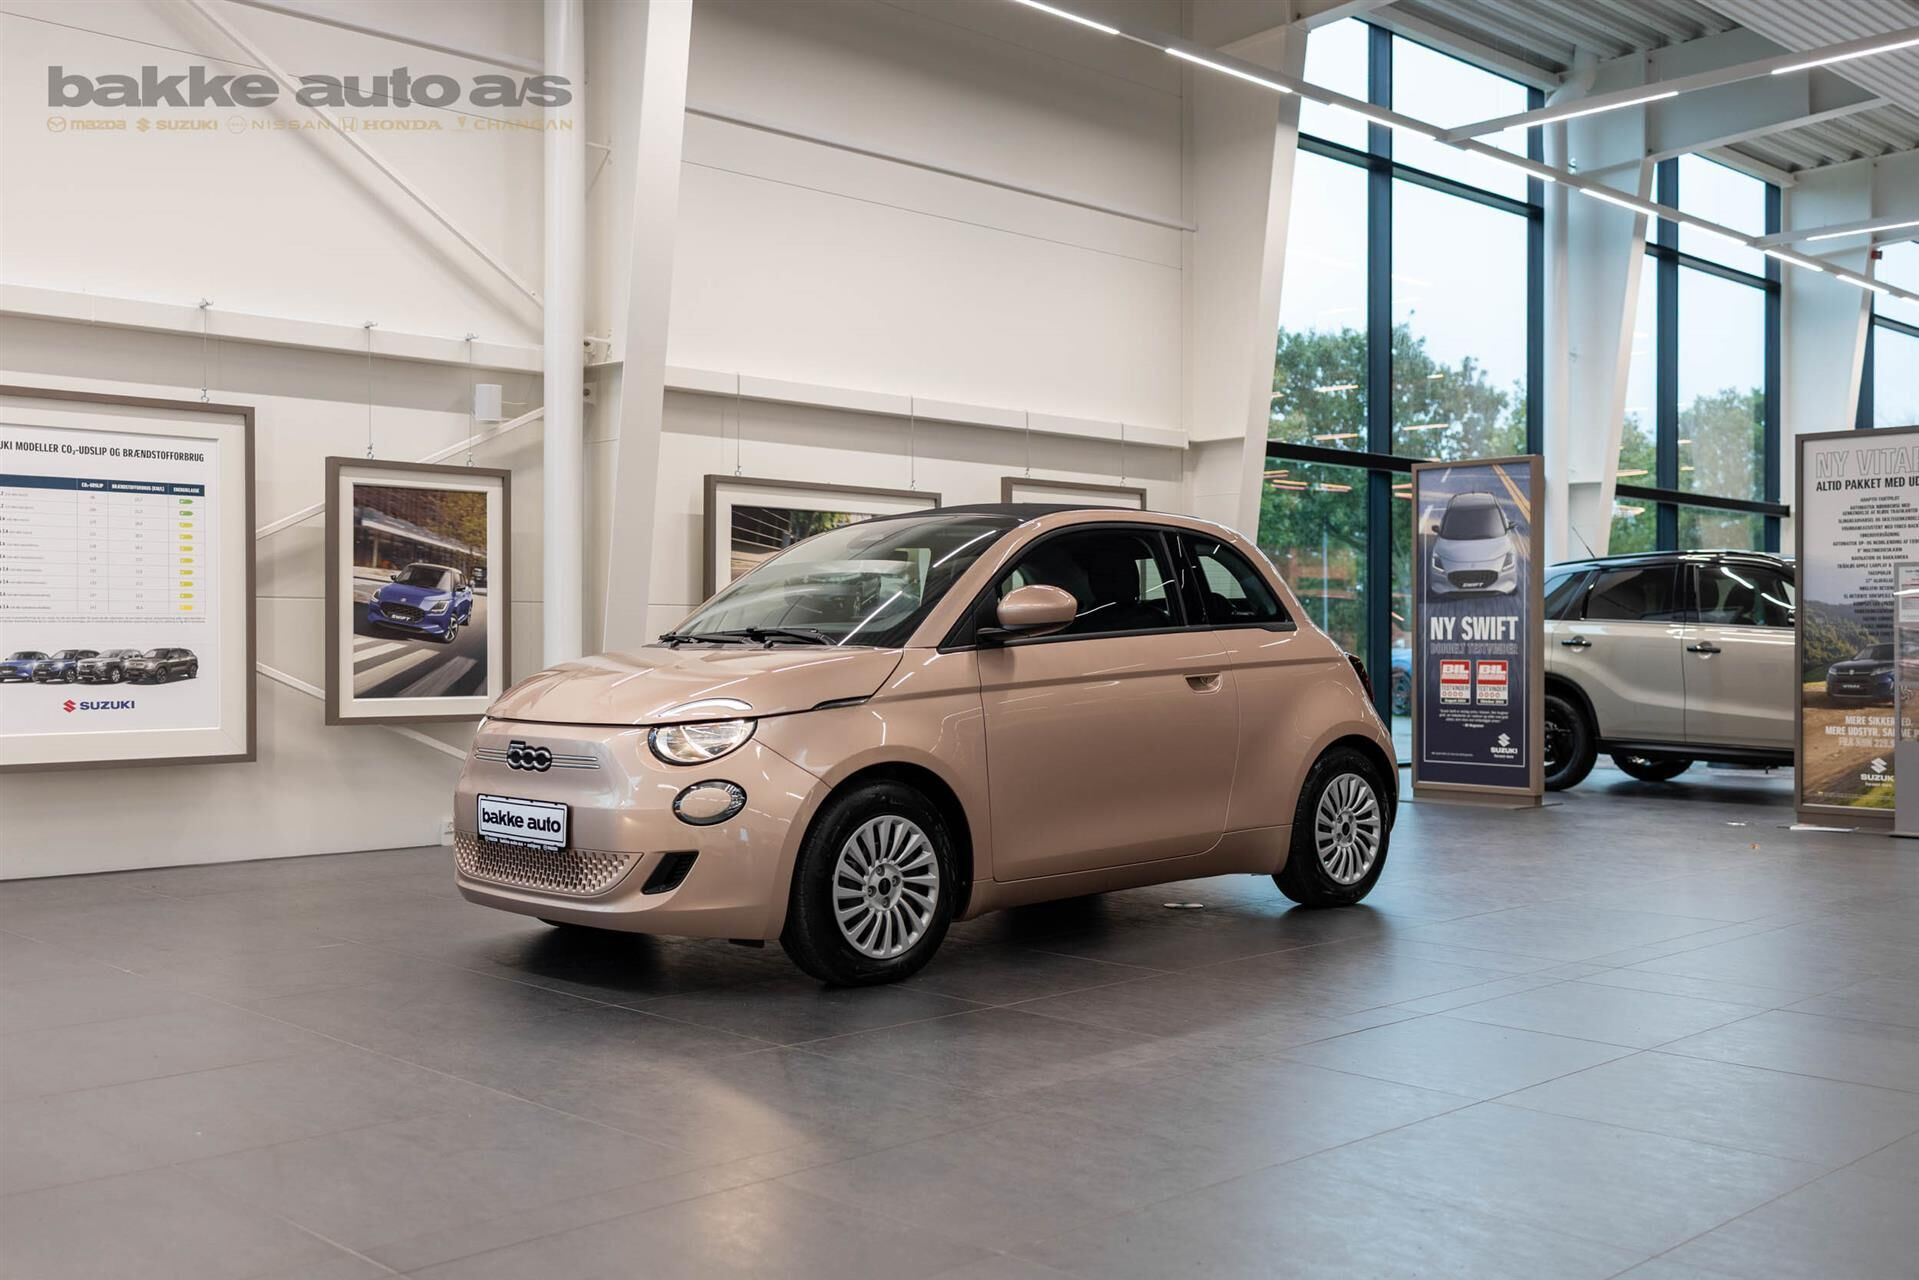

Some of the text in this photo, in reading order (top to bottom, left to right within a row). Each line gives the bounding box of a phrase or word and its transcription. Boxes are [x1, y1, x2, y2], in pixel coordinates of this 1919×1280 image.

[15, 441, 59, 453] MODELLER
[109, 447, 120, 457] OG
[122, 448, 204, 462] BRÆNDSTOFFORBRUG
[1815, 450, 1849, 478] NY
[1816, 480, 1842, 492] ALTID
[1845, 478, 1881, 490] PAKKET
[1884, 476, 1905, 488] MED
[1430, 616, 1519, 641] NY SWIFT
[79, 700, 135, 710] SUZUKI
[1845, 715, 1867, 725] MERE
[1824, 726, 1846, 736] MERE
[1490, 746, 1518, 754] SUZUKI
[1860, 773, 1895, 782] SUZUK
[482, 808, 562, 834] bakke auto
